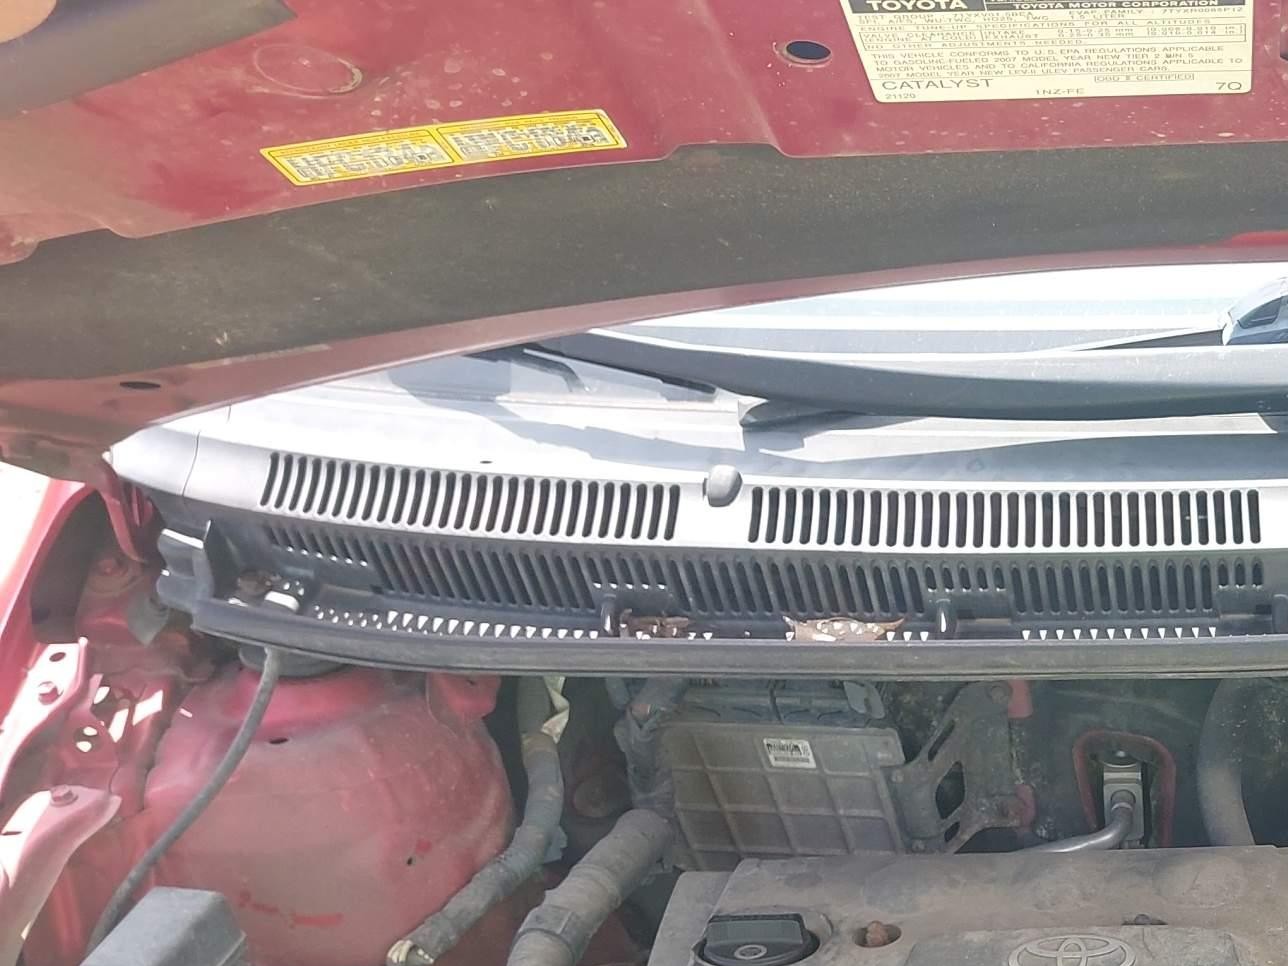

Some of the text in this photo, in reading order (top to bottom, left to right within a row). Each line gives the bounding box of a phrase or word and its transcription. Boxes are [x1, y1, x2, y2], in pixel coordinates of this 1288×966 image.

[865, 0, 969, 11] TOYOTA
[882, 78, 994, 91] CATALYST
[1215, 81, 1242, 91] 7Q
[1036, 88, 1085, 96] 1NZ-FE
